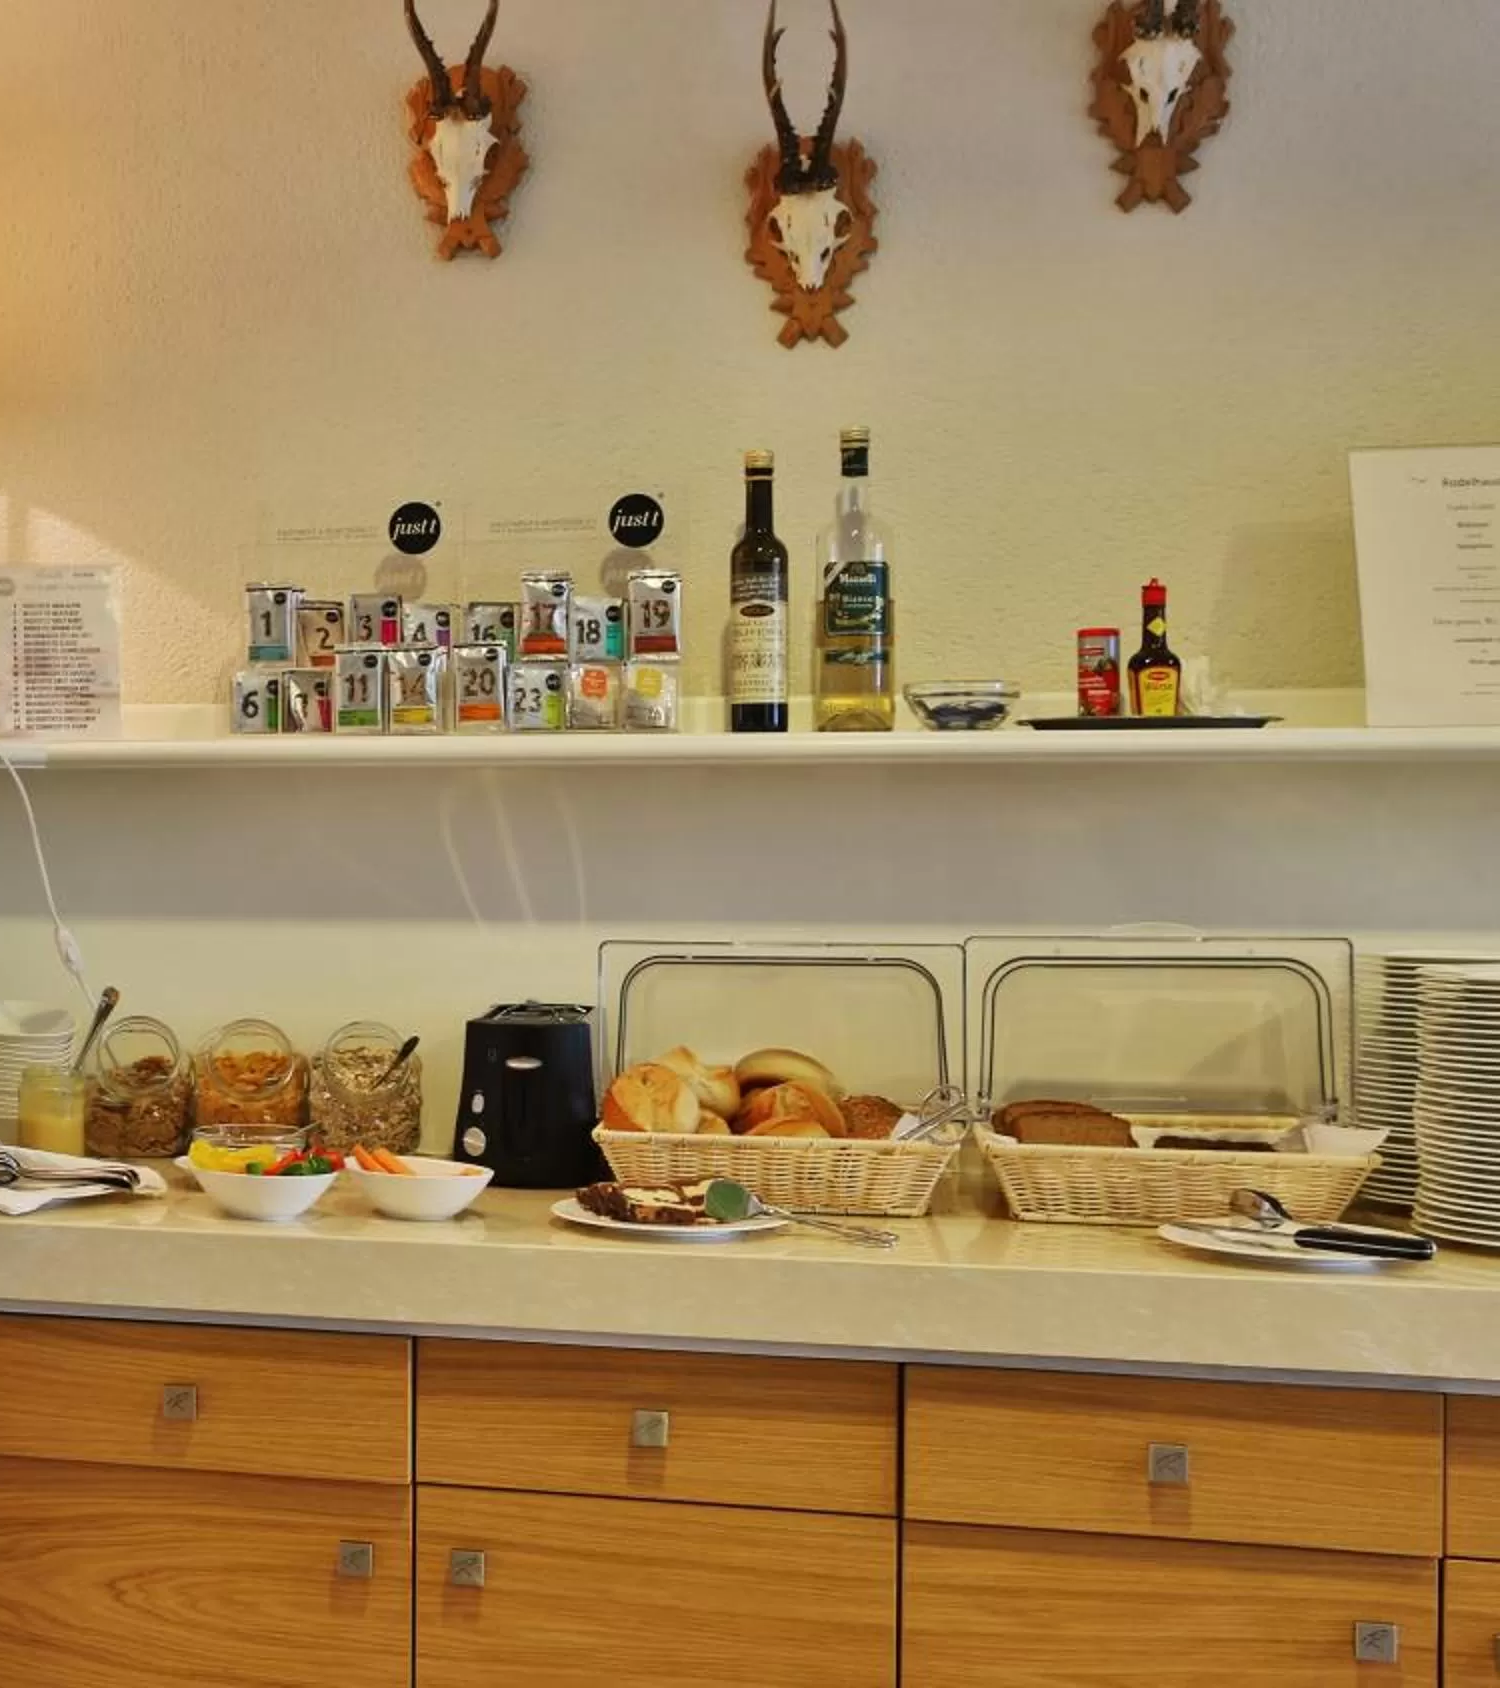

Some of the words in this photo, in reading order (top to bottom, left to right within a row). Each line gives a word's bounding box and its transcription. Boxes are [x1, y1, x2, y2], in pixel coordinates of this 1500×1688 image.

[392, 517, 427, 541] just
[612, 509, 650, 533] just
[260, 609, 272, 638] 1
[359, 614, 373, 641] 3
[640, 599, 671, 629] 19
[315, 626, 335, 650] 2
[575, 618, 601, 645] 18
[345, 673, 368, 703] 11
[462, 667, 497, 697] 20
[242, 690, 259, 719] 6
[513, 687, 542, 713] 23
